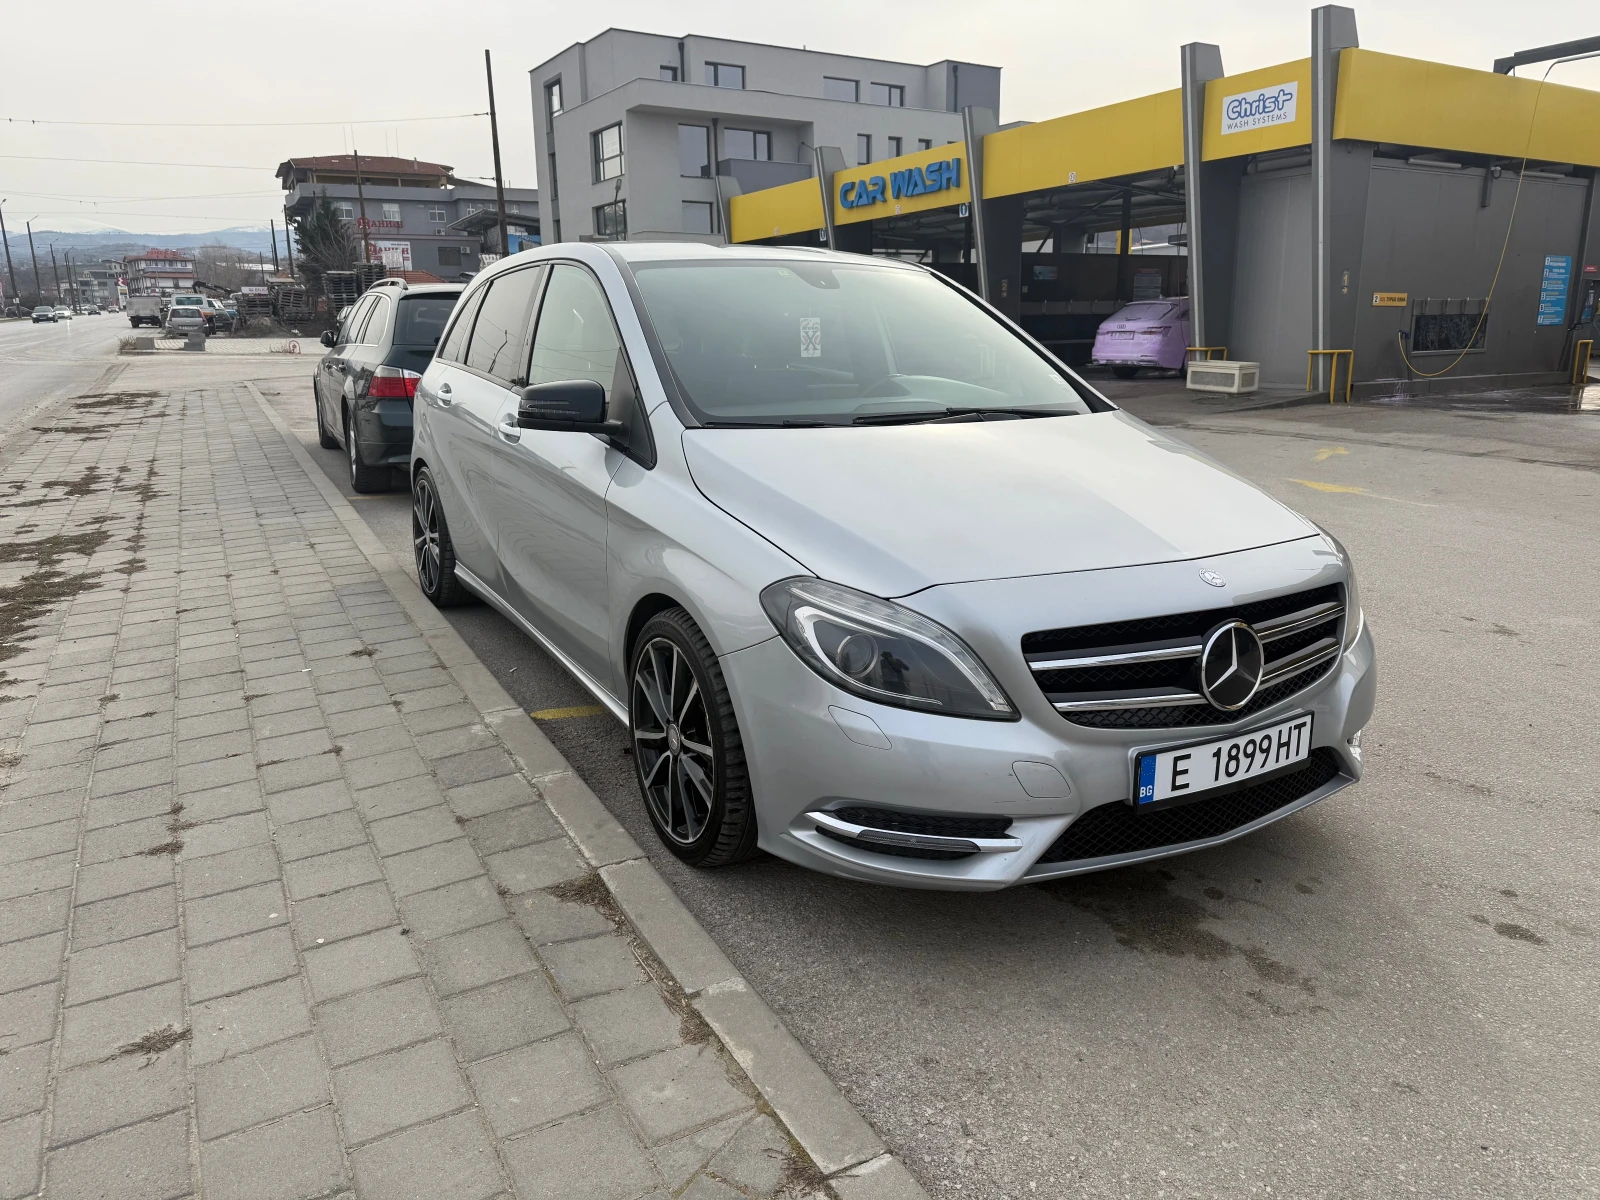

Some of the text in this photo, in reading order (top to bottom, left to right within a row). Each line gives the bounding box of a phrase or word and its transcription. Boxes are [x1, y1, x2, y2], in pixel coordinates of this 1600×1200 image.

[1227, 89, 1293, 120] Christ
[1227, 112, 1287, 130] WASH SYSTEMS
[840, 158, 961, 209] CAR WASH
[1170, 753, 1191, 792] E
[1139, 785, 1153, 797] BG
